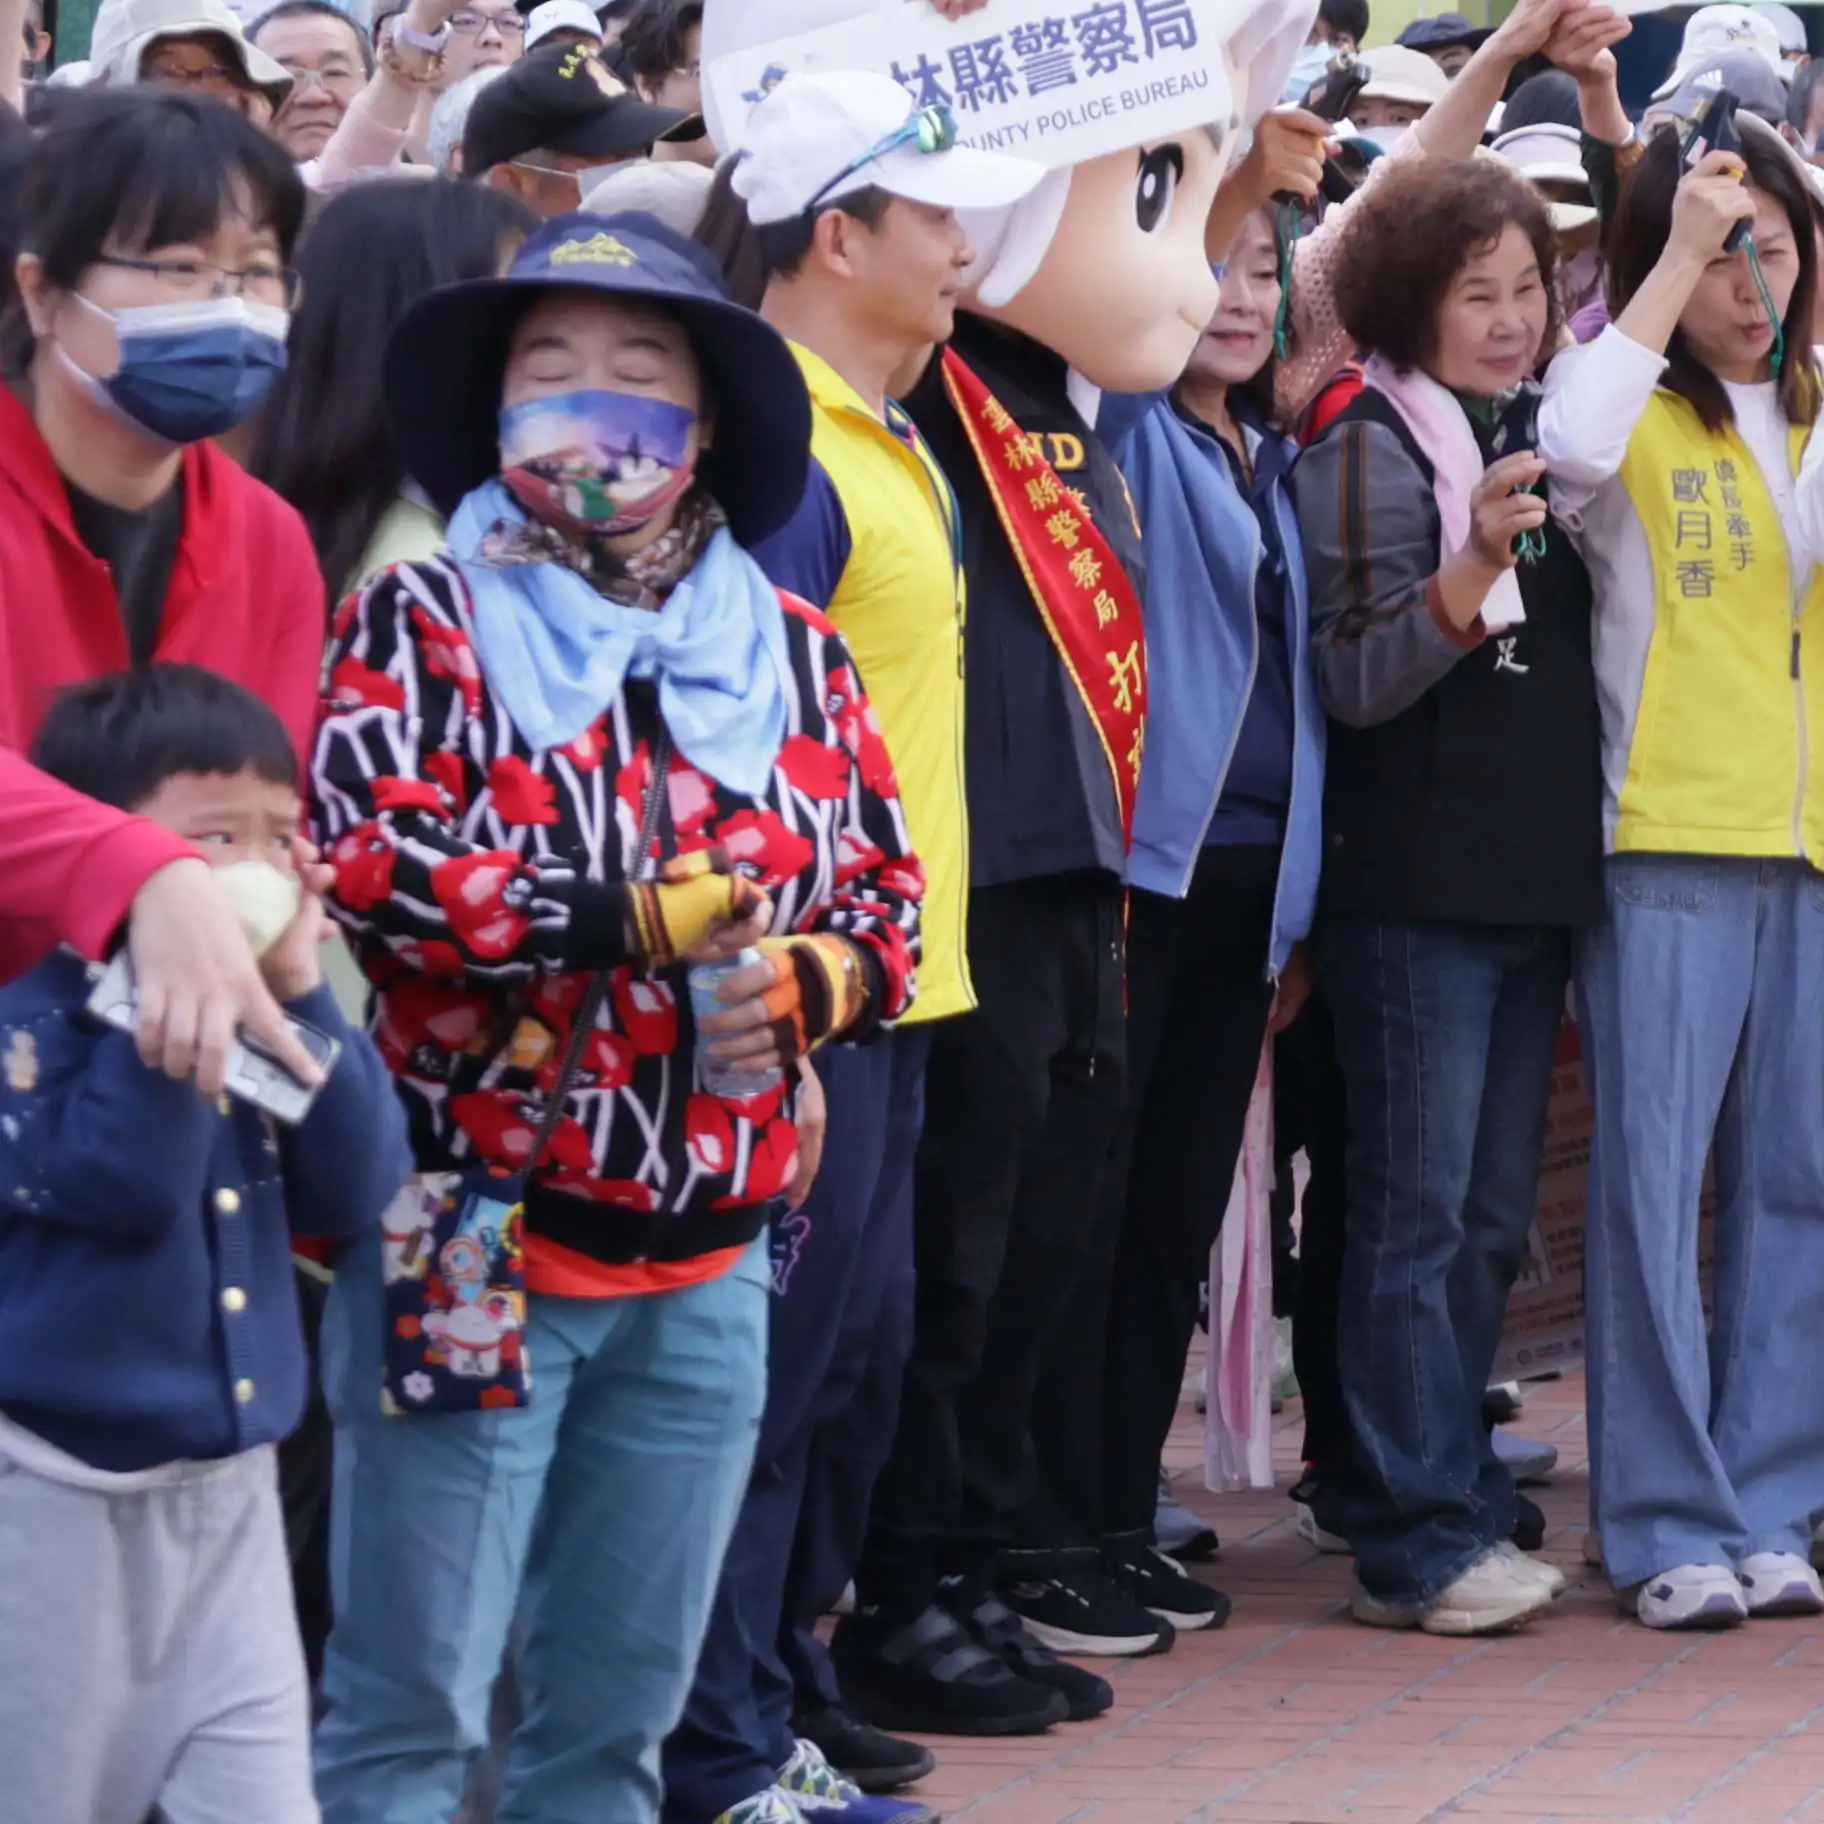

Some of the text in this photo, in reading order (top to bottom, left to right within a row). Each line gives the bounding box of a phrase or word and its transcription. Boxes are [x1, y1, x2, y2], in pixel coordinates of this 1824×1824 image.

[1036, 100, 1118, 136] POLICE
[1122, 69, 1210, 110] BUREAU
[1671, 467, 1716, 598] 歐月香
